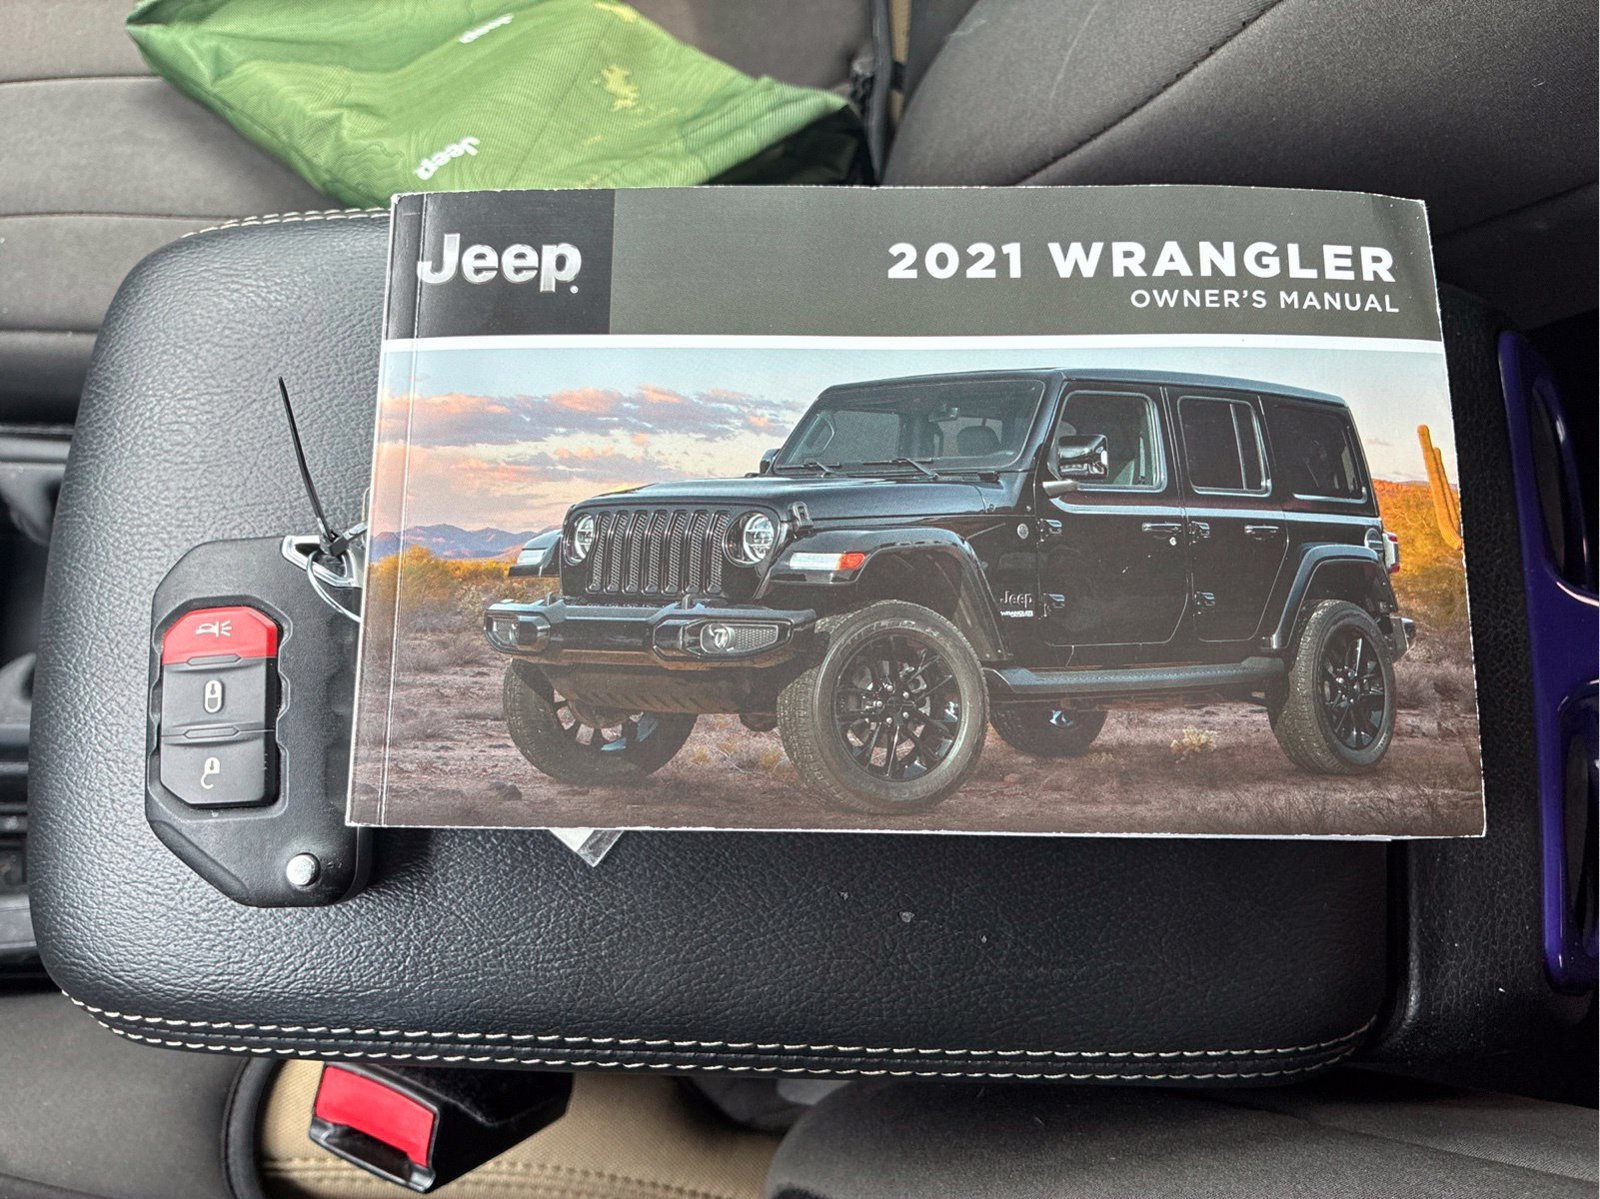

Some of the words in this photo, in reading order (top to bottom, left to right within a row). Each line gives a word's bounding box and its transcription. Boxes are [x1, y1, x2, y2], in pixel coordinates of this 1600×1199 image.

[415, 136, 480, 180] Jeep
[417, 233, 582, 292] Jeep
[887, 242, 1022, 280] 2021
[1048, 241, 1396, 283] WRANGLER
[1130, 289, 1267, 309] OWNER'S
[1280, 291, 1400, 313] MANUAL
[1000, 591, 1032, 608] Jeep
